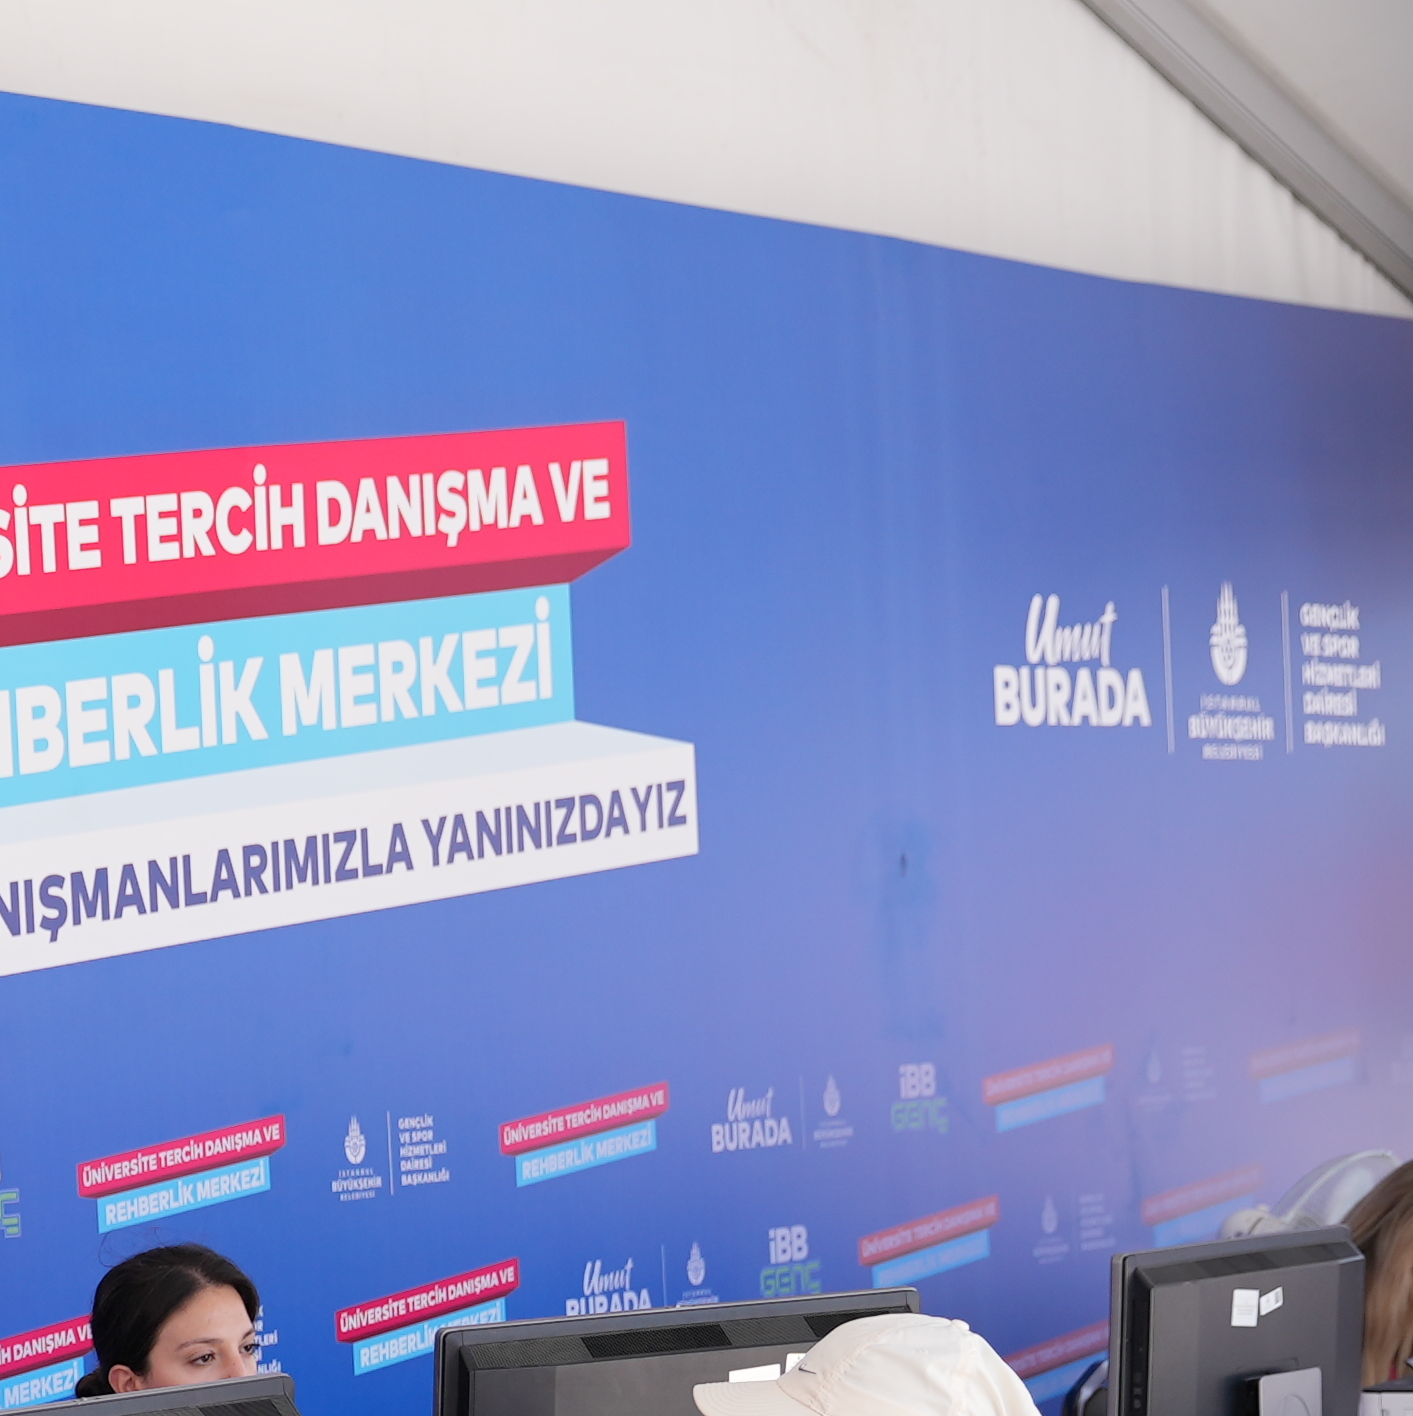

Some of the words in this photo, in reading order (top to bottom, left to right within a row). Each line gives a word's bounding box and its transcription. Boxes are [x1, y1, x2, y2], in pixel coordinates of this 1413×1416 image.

[109, 463, 308, 565] TERCİH
[316, 465, 543, 549] DANIŞMA
[547, 458, 612, 525] VE
[1025, 592, 1119, 667] Umut
[278, 596, 555, 738] MERKEZİ
[993, 664, 1153, 728] BURADA
[420, 778, 689, 869] YANINIZDAYIZ
[82, 1152, 158, 1188] ÜNİVERSİTE
[158, 1139, 204, 1168] TERCİH
[205, 1129, 263, 1157] DANIŞMA
[263, 1123, 281, 1142] VE
[503, 1114, 565, 1146] ÜNİVERSİTE
[565, 1104, 602, 1128] TERCİH
[711, 1116, 793, 1153] BURADA
[104, 1180, 195, 1225] REHBERLİK
[196, 1159, 267, 1202] MERKEZİ
[340, 1297, 407, 1333] ÜNİVERSİTE
[407, 1286, 447, 1312] TERCİH
[447, 1273, 500, 1301] DANIŞMA
[499, 1265, 516, 1285] VE
[13, 1328, 76, 1361] DANIŞMA
[4, 1361, 79, 1406] MERKEZİ
